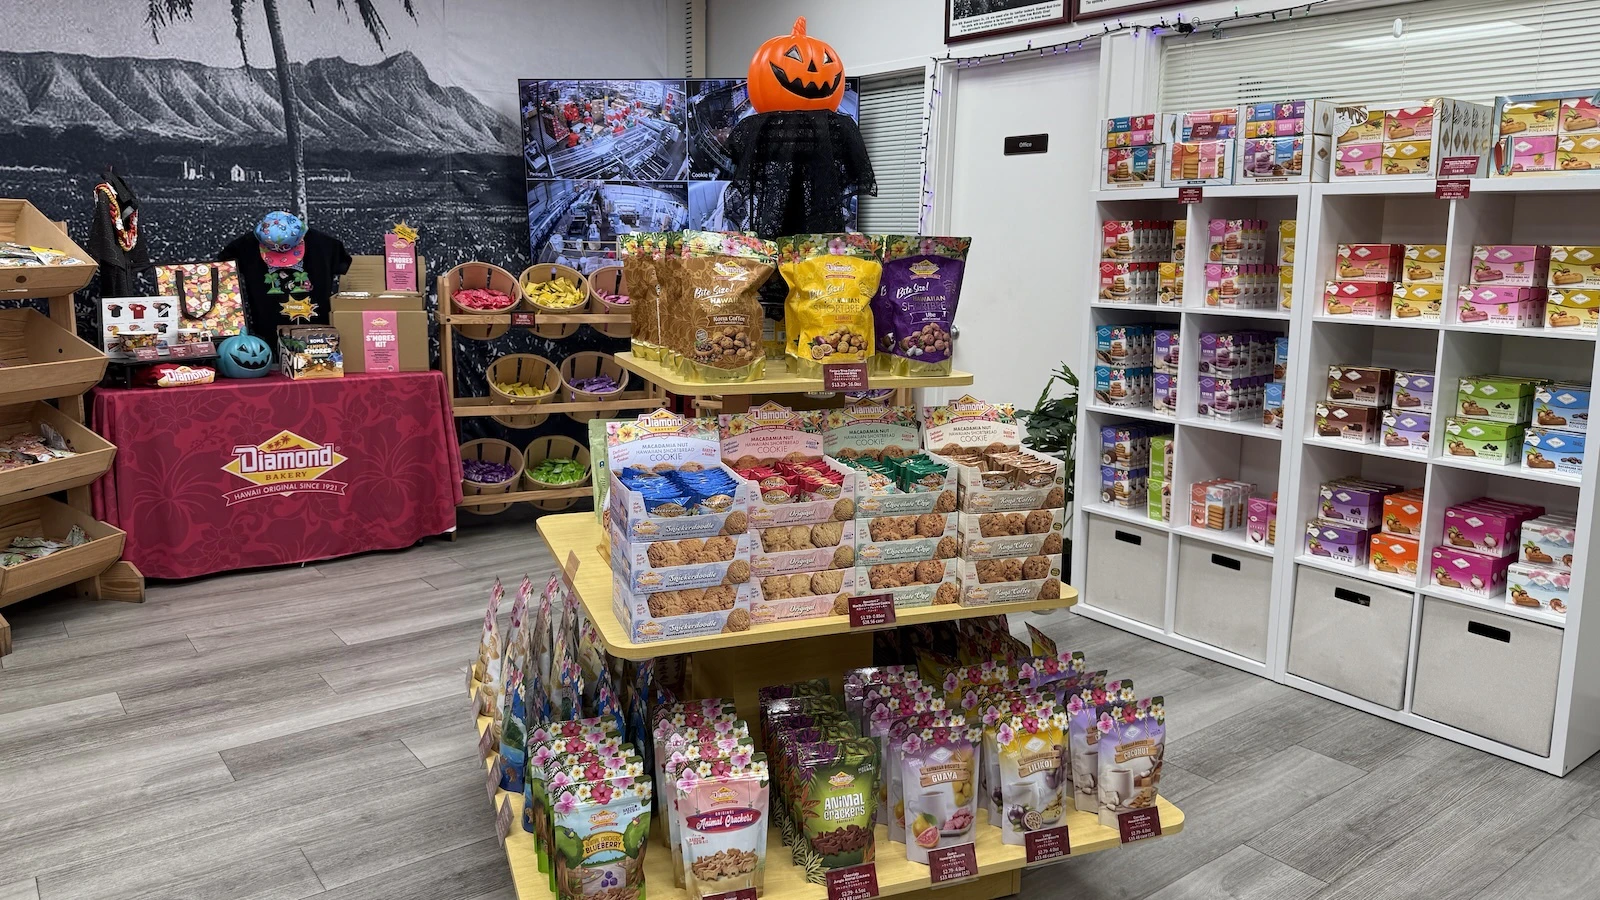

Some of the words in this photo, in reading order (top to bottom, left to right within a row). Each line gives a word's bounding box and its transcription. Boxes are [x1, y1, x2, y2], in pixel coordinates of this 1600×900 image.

[694, 288, 711, 298] Bite
[713, 283, 735, 295] Size!
[896, 286, 912, 299] Bite
[912, 282, 929, 292] Size!
[160, 368, 212, 382] Diamond
[850, 405, 884, 414] Diamond
[952, 402, 984, 411] Diamond
[752, 410, 790, 419] Diamond
[640, 417, 683, 427] Diamond
[232, 444, 333, 474] Diamond
[650, 454, 683, 462] COOKIE
[265, 471, 307, 481] BAKERY
[234, 488, 261, 500] HAWAII
[263, 483, 297, 494] ORIGINAL
[884, 501, 914, 509] Chocolate
[789, 509, 816, 518] Original
[665, 522, 714, 532] Snickerdoodle
[789, 557, 816, 566] Original
[668, 572, 716, 582] Snickerdoodle
[789, 604, 816, 614] Original
[669, 621, 716, 632] Snickerdoodle
[1124, 747, 1149, 759] COCONUT
[1028, 760, 1052, 772] LILIKOI
[932, 772, 957, 782] GUAVA
[696, 816, 722, 830] Animal
[725, 813, 753, 827] Crackers
[586, 842, 621, 853] BLUEBERRY
